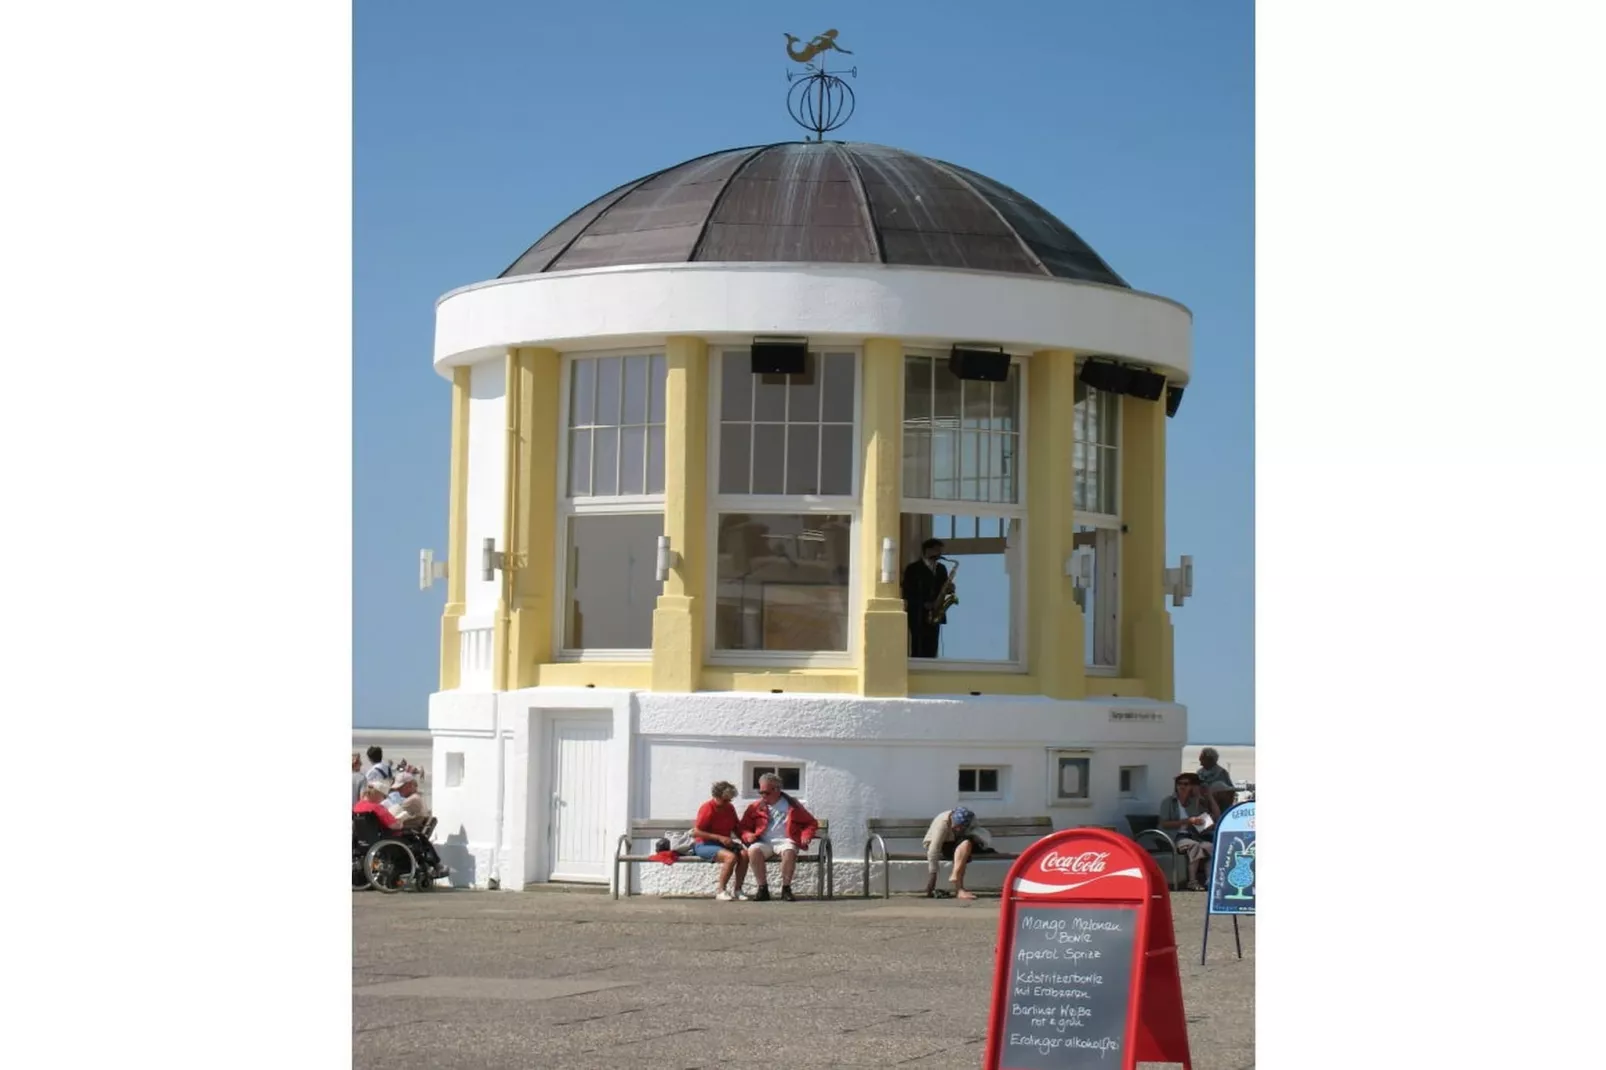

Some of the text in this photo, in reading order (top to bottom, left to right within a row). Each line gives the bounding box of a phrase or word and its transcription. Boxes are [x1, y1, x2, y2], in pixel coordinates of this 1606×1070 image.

[1040, 851, 1111, 873] Coca-Cola
[1022, 916, 1066, 940] Mango
[1058, 931, 1092, 943] Bowle
[1018, 948, 1060, 966] Aperol
[1012, 1003, 1057, 1016] Berliner
[1031, 1018, 1046, 1027] rot
[1010, 1033, 1120, 1059] Erdinger alkoholfrei
